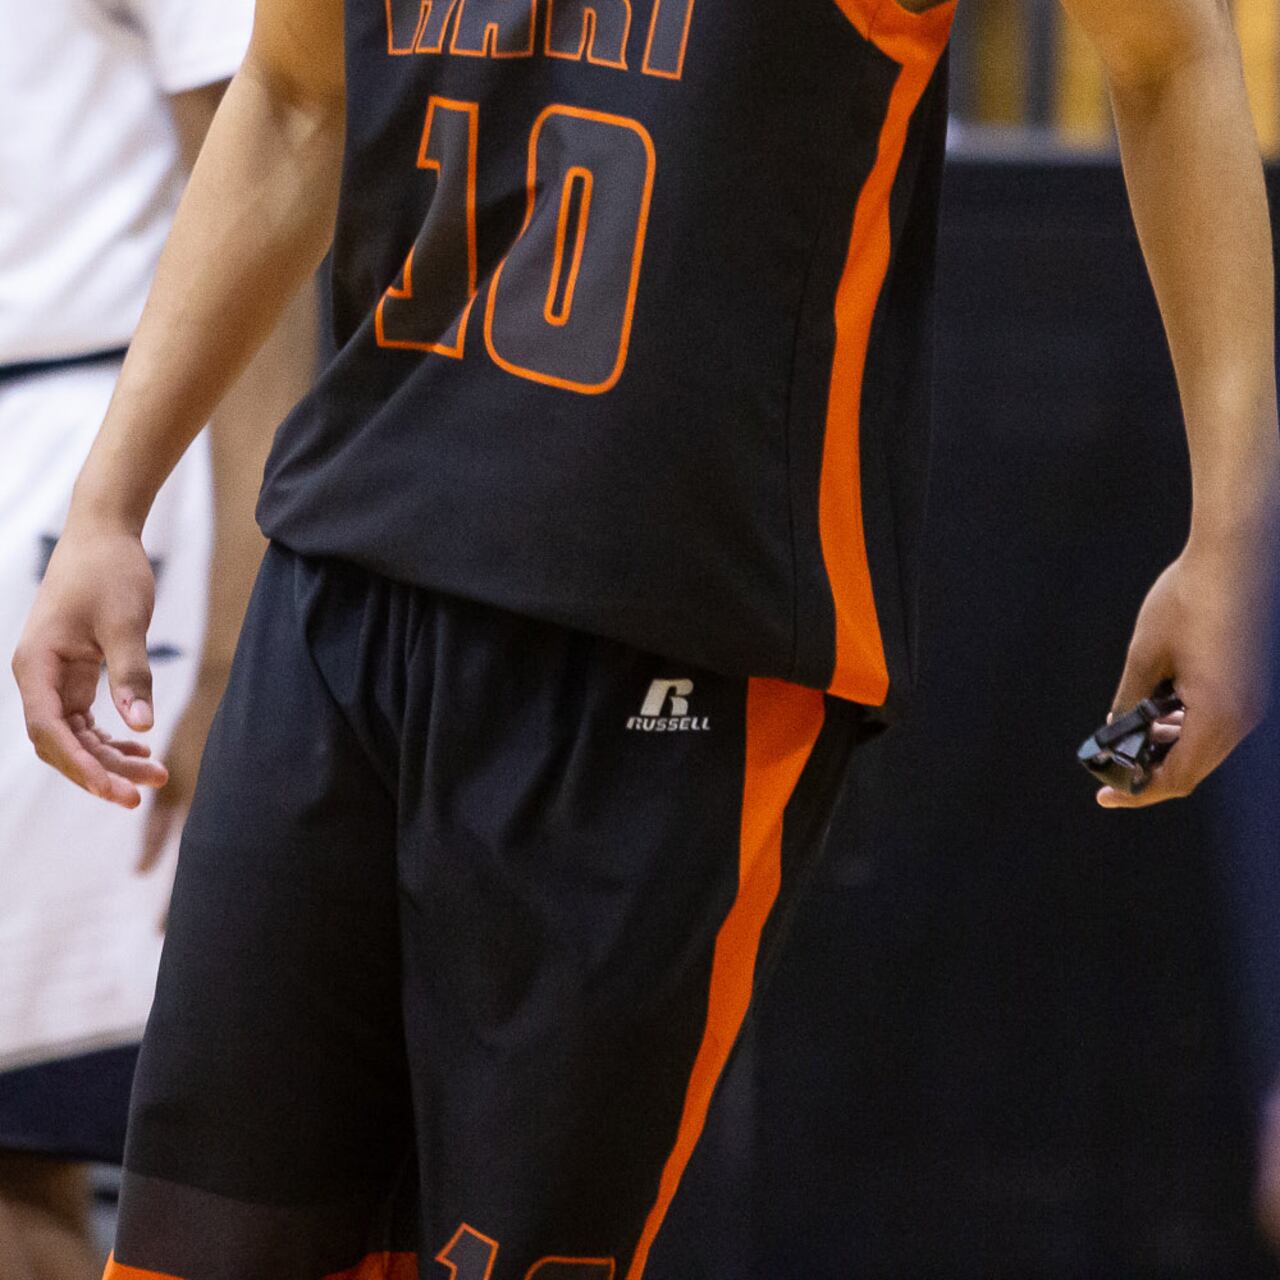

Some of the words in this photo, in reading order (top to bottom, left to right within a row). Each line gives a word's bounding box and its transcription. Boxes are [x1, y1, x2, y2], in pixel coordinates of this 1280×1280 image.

[375, 95, 656, 395] 10
[640, 678, 695, 716] R
[626, 716, 711, 732] RUSSELL
